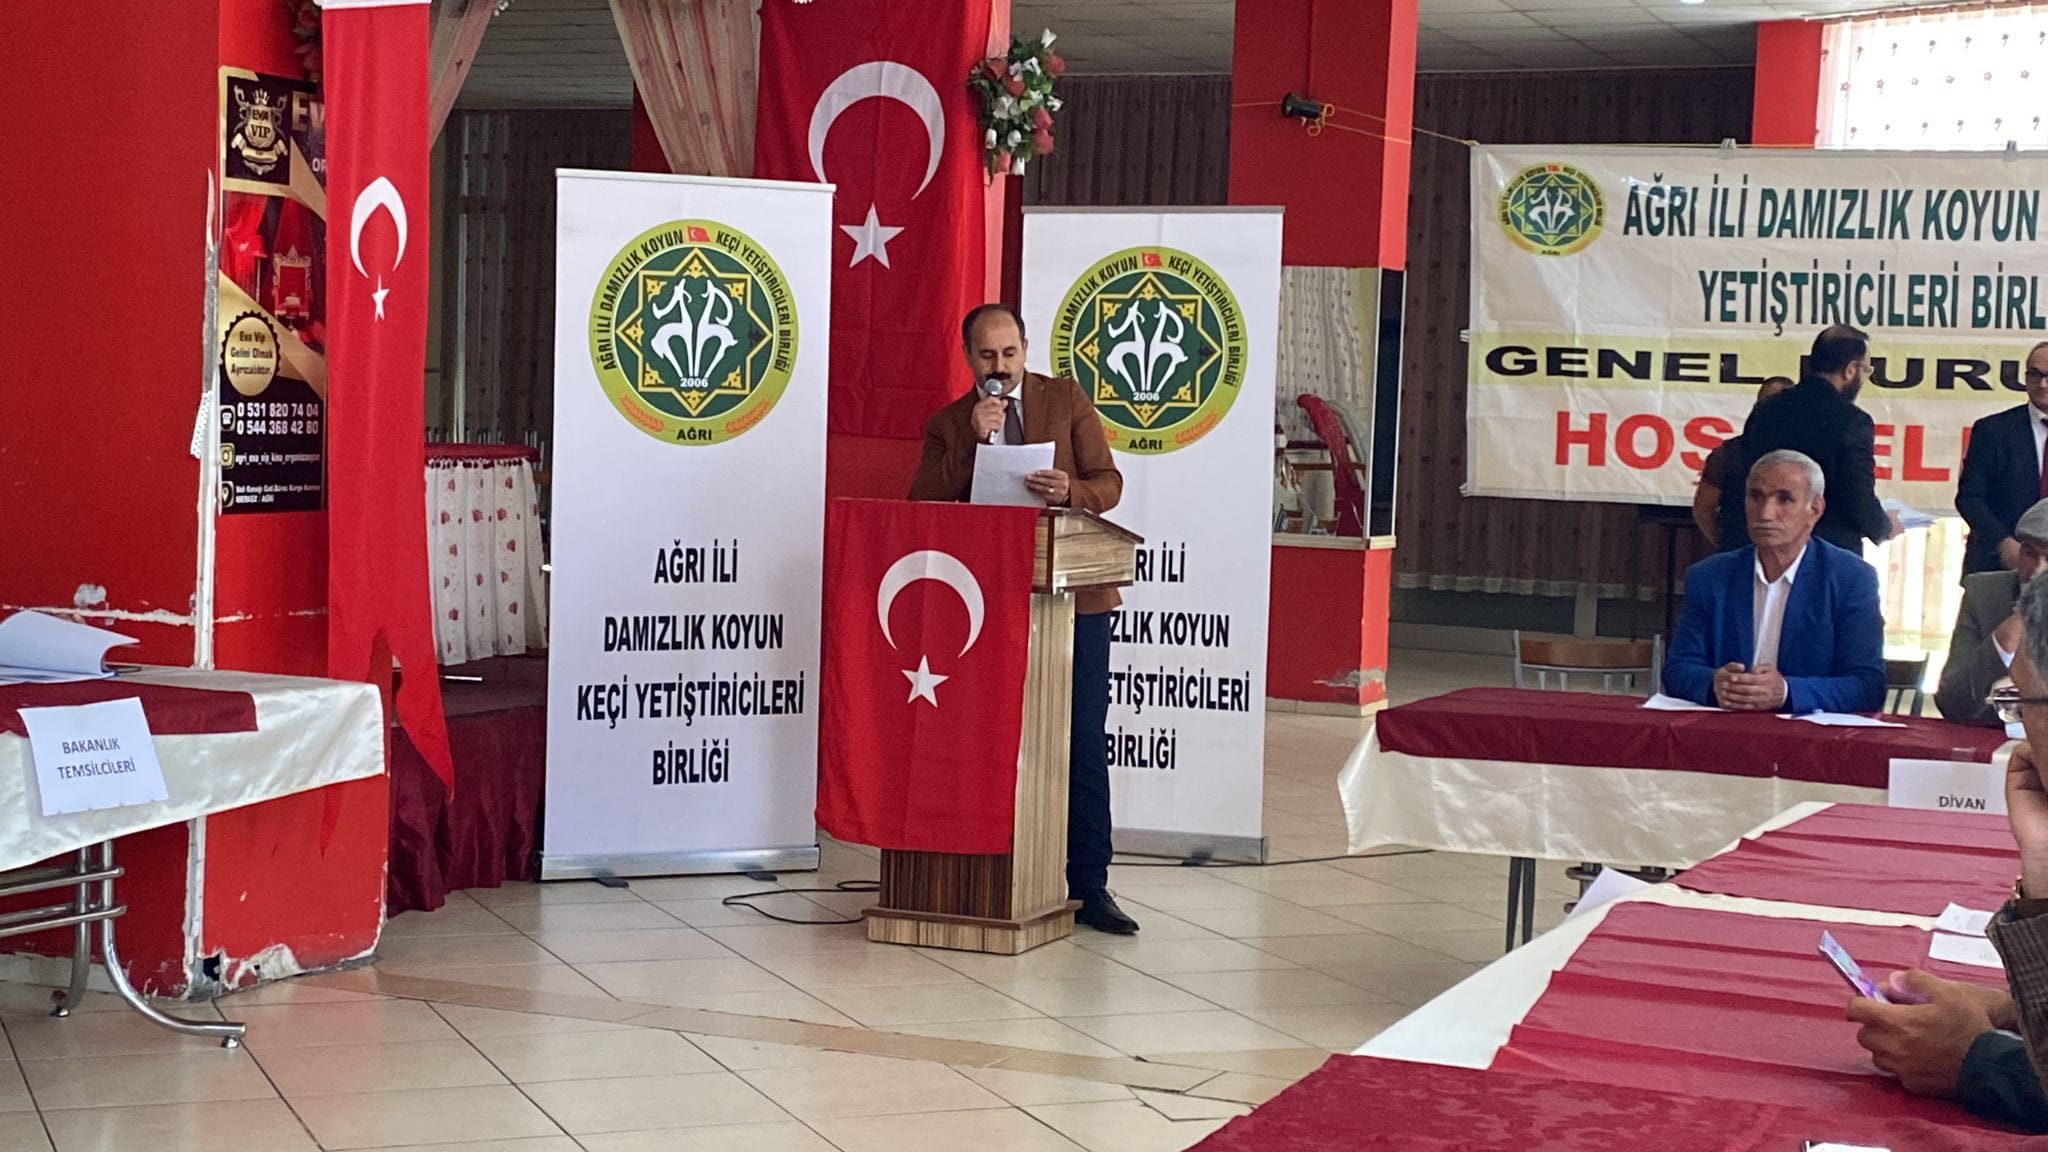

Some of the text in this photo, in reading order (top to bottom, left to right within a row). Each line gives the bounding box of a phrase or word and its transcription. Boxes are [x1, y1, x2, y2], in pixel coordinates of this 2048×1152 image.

[250, 124, 271, 138] VIP
[252, 109, 270, 121] EVA
[1623, 172, 1698, 236] AĞRI
[1709, 174, 1748, 237] İLİ
[1757, 187, 1913, 240] DAMIZLIK
[1922, 189, 2040, 242] KOYUN
[1098, 256, 1138, 282] KOYUN
[1168, 256, 1193, 277] KEÇİ
[594, 229, 684, 371] AĞRI İLİ DAMIZLIK KOYUN
[716, 230, 793, 373] KEÇİ YETİŞTİRİCİLERİ BİRLİĞİ
[1060, 276, 1099, 332] DAMIZLIK
[1698, 258, 1960, 336] YETİŞTİRİCİLERİ
[1057, 356, 1073, 379] ĞRI
[1485, 345, 1765, 384] GENEL
[680, 377, 709, 388] 2006
[1133, 392, 1160, 401] 2006
[237, 402, 319, 417] 0 531 820 74 04
[237, 420, 244, 435] 0
[246, 420, 266, 435] 544
[269, 420, 288, 434] 368
[290, 420, 304, 434] 42
[676, 427, 712, 441] AĞRI
[1129, 437, 1162, 450] AĞRI
[654, 538, 738, 584] AĞRI İLİ
[1135, 541, 1185, 583] RI İLİ
[603, 613, 784, 652] DAMIZLIK KOYUN
[1110, 610, 1230, 648] ZLIK KOYUN
[577, 670, 804, 730] KEÇİ YETİŞTİRİCİLERİ
[1107, 664, 1250, 714] TİŞTİRİCİLERİ
[62, 737, 121, 755] BAKANLIK
[653, 738, 729, 785] BİRLİĞİ
[1105, 725, 1176, 770] BİRLİĞİ
[57, 756, 136, 780] TEMSİLCİLERİ
[1938, 794, 1986, 810] DİVAN
